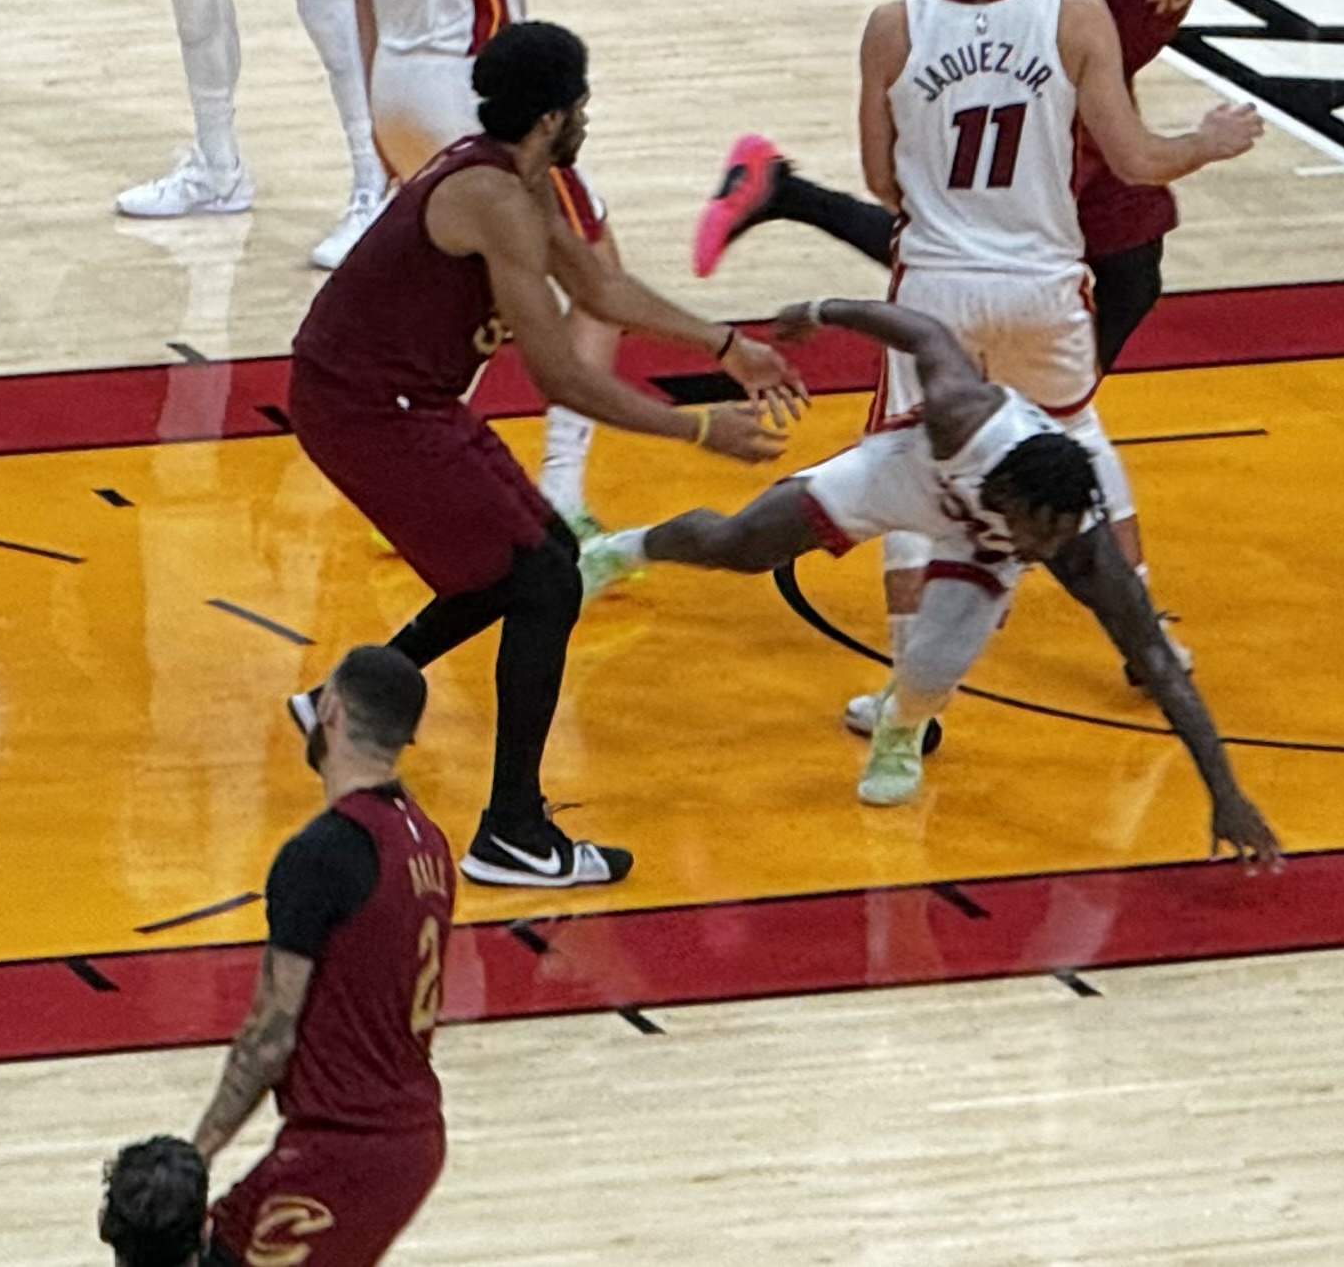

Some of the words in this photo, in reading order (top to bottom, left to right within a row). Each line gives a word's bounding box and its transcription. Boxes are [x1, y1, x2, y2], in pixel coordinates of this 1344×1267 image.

[913, 41, 1014, 102] JAQUEZ
[1013, 55, 1054, 100] JR.
[947, 101, 1029, 191] 11
